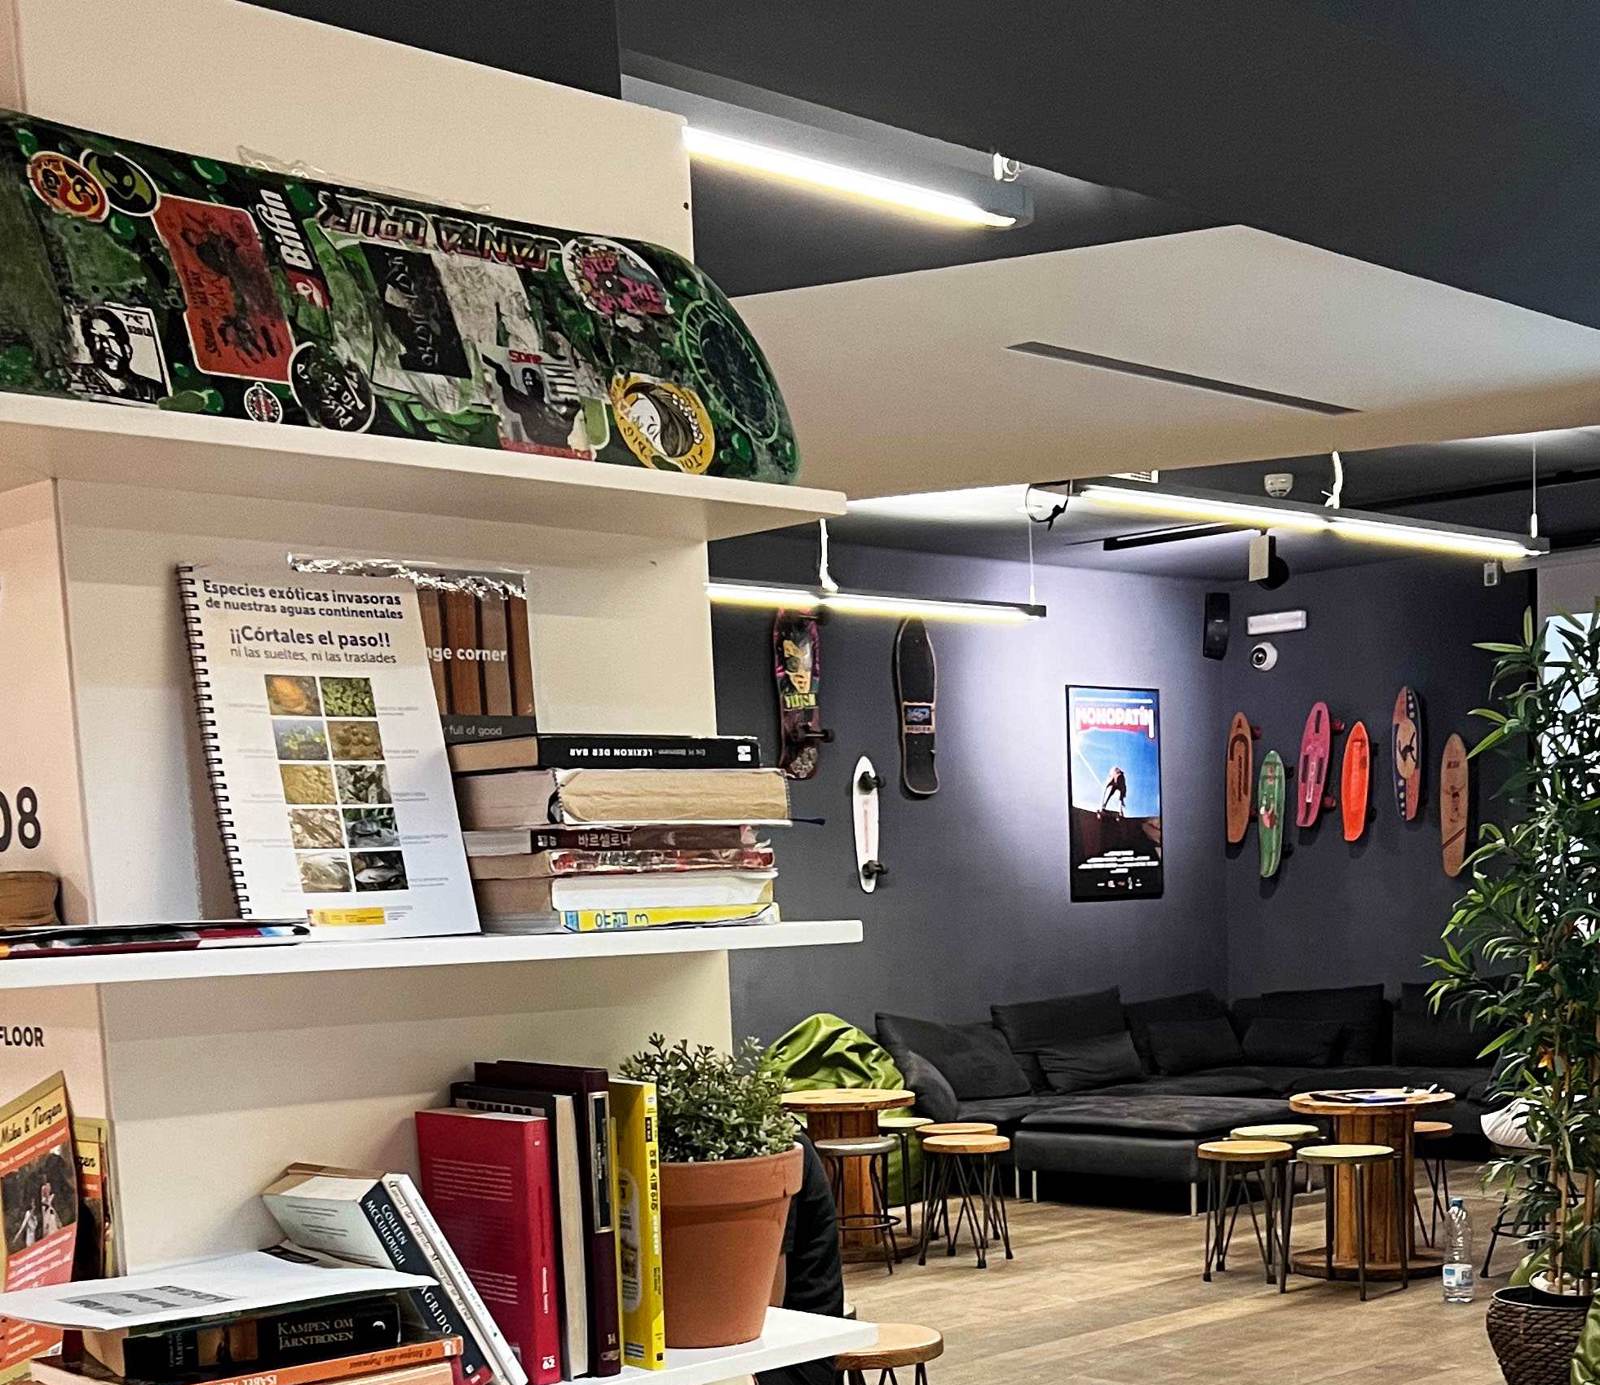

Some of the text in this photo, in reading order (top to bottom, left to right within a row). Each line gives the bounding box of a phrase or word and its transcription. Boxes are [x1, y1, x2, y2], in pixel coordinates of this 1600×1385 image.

[204, 580, 401, 606] Especies exóticas invasoras
[206, 598, 403, 620] de nuestras aguas continentales
[318, 629, 333, 646] el
[338, 632, 391, 649] paso!!
[230, 646, 241, 657] ni
[245, 646, 261, 658] las
[312, 649, 321, 660] ni
[325, 651, 341, 662] las
[344, 652, 397, 665] traslades
[457, 647, 507, 662] corner
[450, 725, 503, 737] full of good
[569, 748, 589, 758] BAR
[593, 748, 609, 758] DER
[613, 748, 652, 758] LEXIKON
[577, 832, 632, 848] 바르셀로나
[418, 1284, 454, 1336] AGRIDO
[277, 1317, 354, 1337] KAMPEN OM
